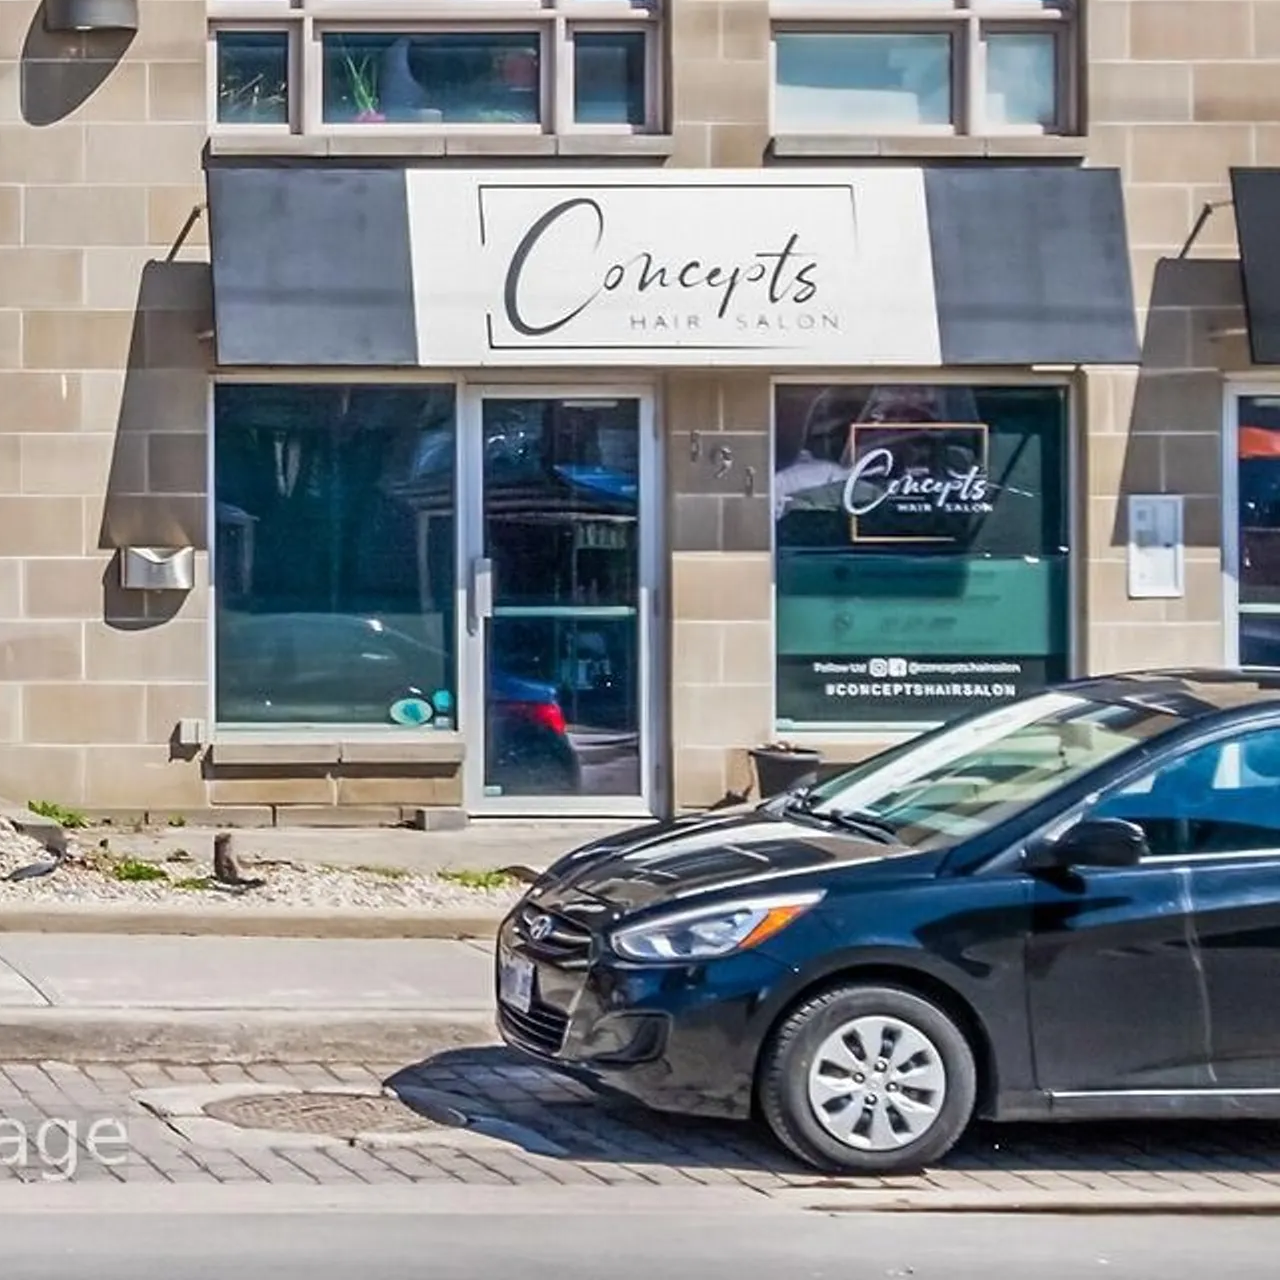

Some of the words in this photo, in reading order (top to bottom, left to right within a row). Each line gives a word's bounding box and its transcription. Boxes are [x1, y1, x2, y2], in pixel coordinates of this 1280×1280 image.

[504, 197, 817, 336] Concepts
[630, 314, 702, 330] HAIR
[736, 314, 841, 330] SALON
[844, 448, 988, 514] Concepts
[896, 503, 932, 512] HAIR
[945, 503, 993, 512] SALON
